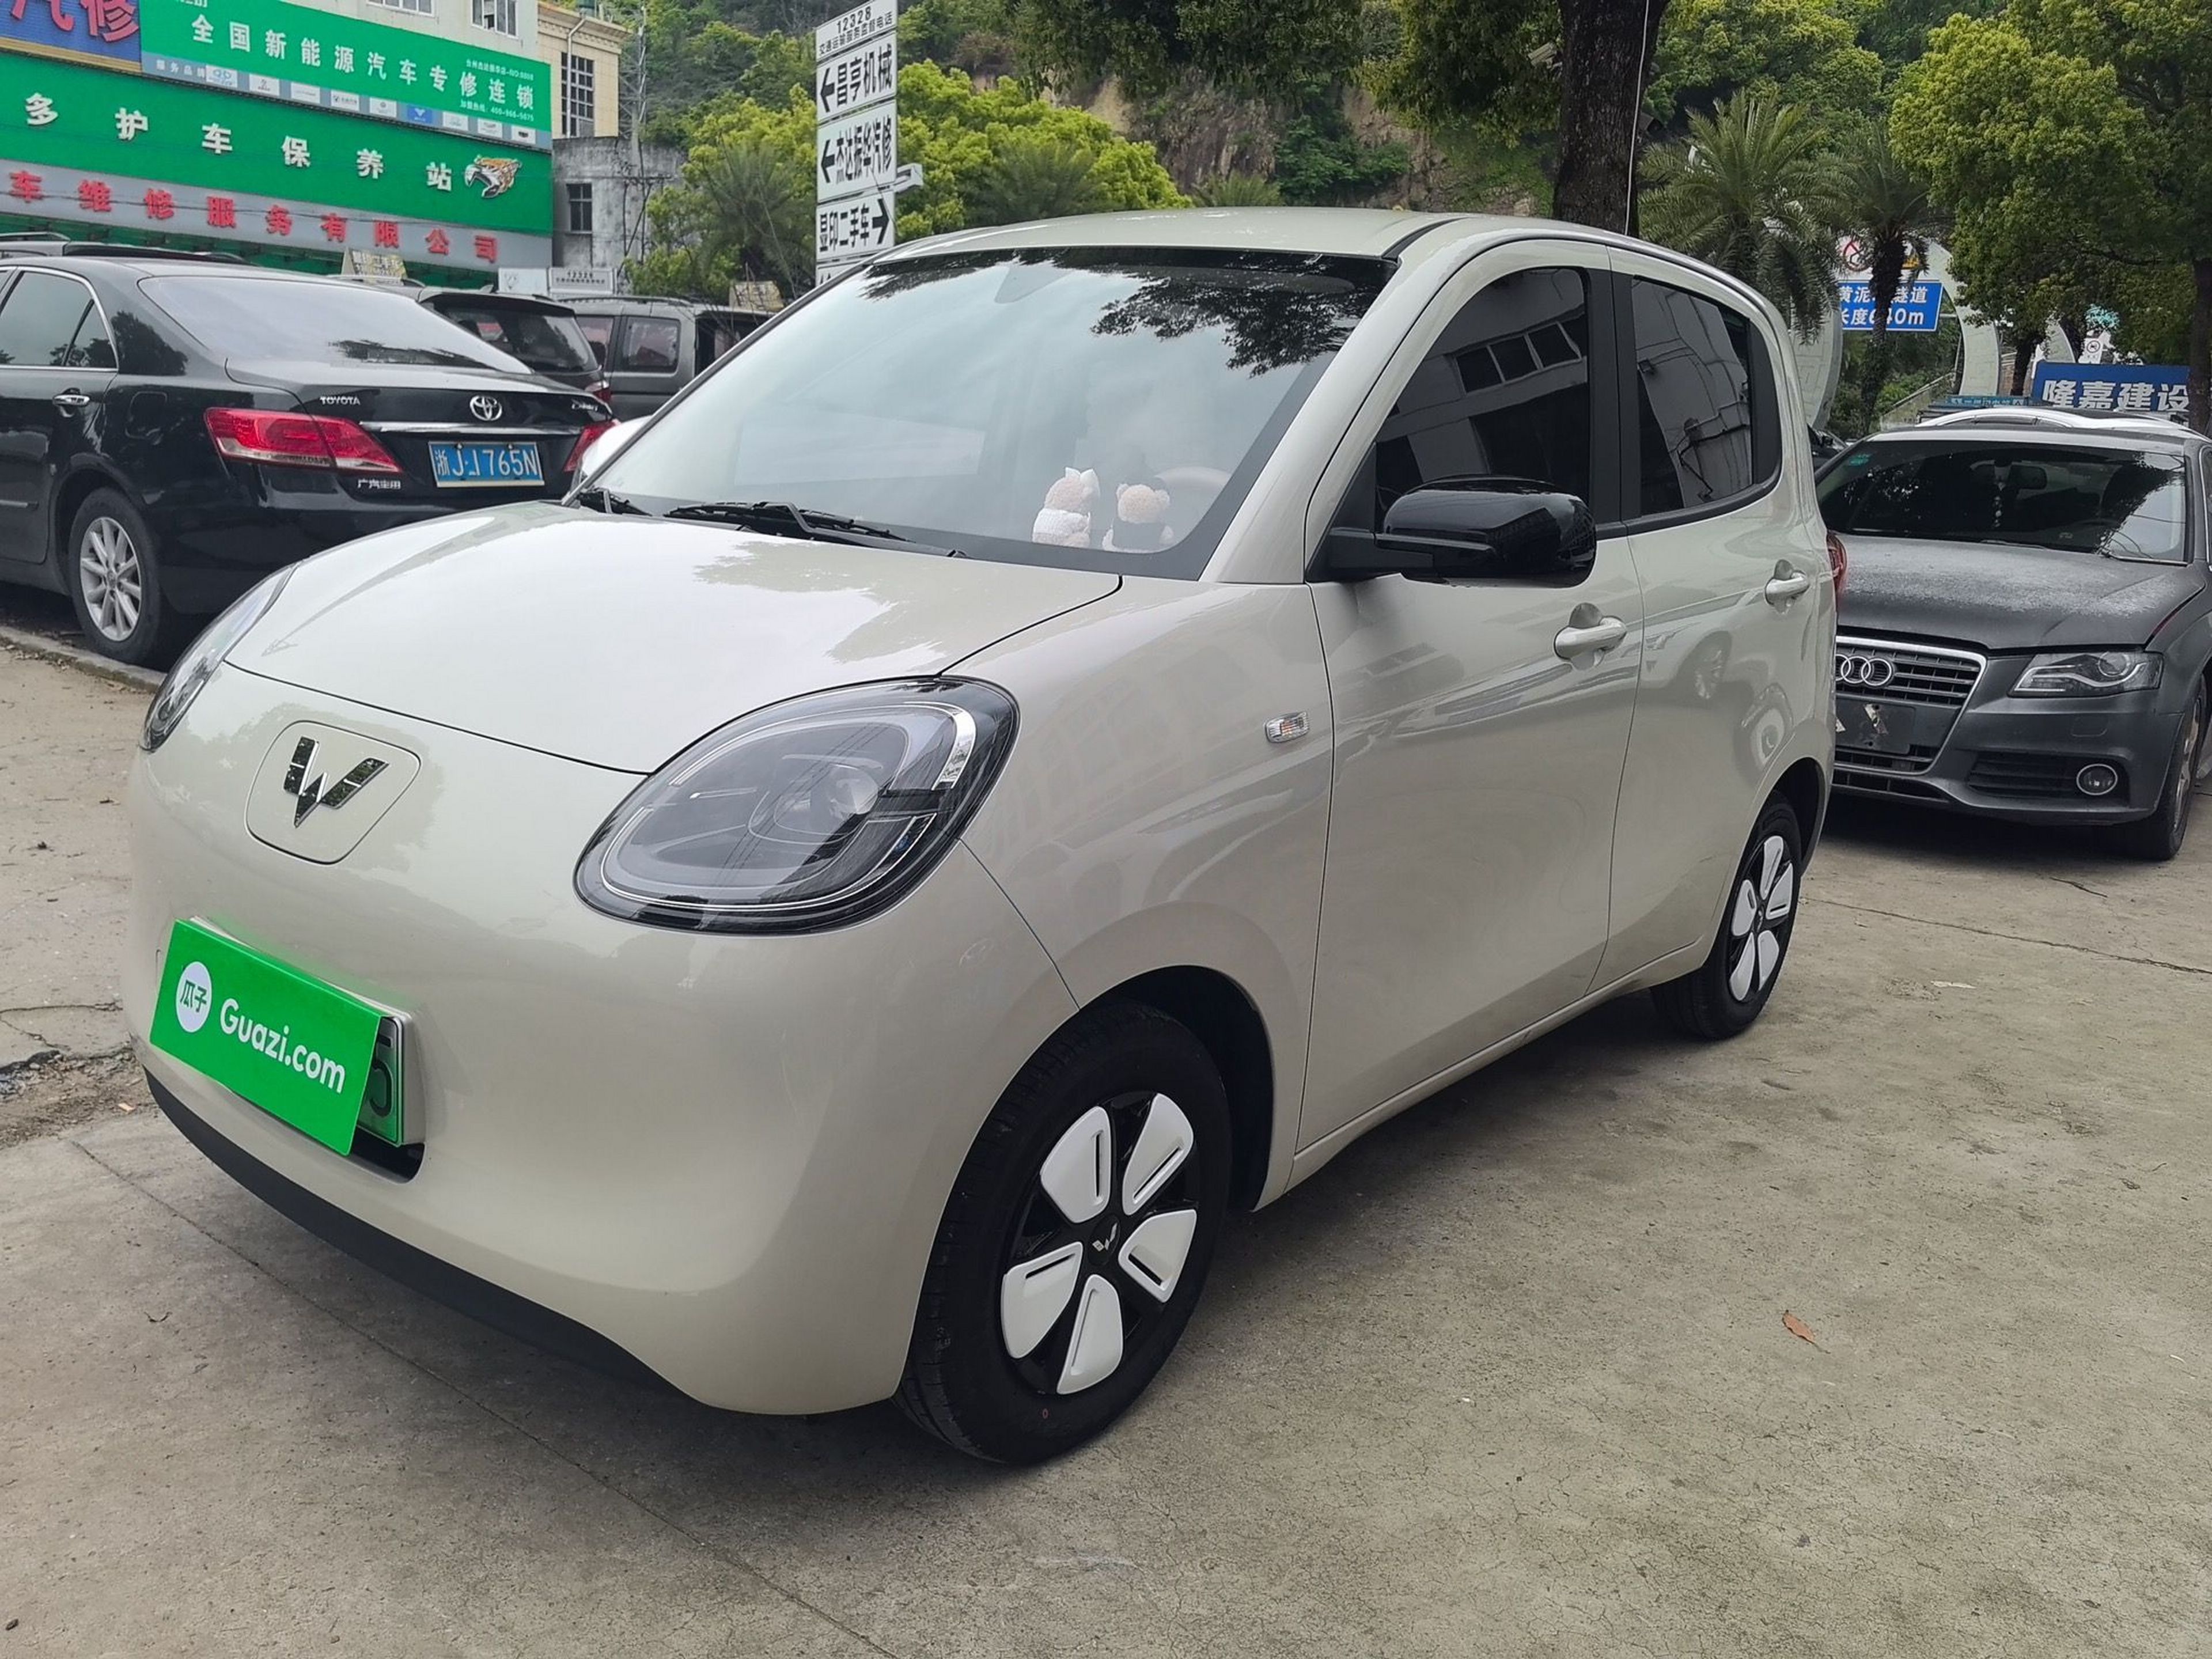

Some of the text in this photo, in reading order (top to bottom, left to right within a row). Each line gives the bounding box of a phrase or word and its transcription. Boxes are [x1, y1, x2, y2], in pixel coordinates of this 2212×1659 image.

[819, 12, 892, 55] 交通运输服务监督电话
[836, 6, 871, 33] 12328
[191, 14, 534, 111] 全国新能源汽车专修连锁
[837, 43, 892, 106] 昌亨机械
[25, 92, 452, 192] 多护车保养站
[10, 171, 498, 264] 车维修服务有限公司
[1839, 286, 1928, 304] 黄泥隧道
[320, 396, 361, 405] TOYOTA
[2042, 380, 2190, 412] 隆嘉建设
[180, 980, 207, 1013] 瓜子
[219, 998, 345, 1094] Guazi.com
